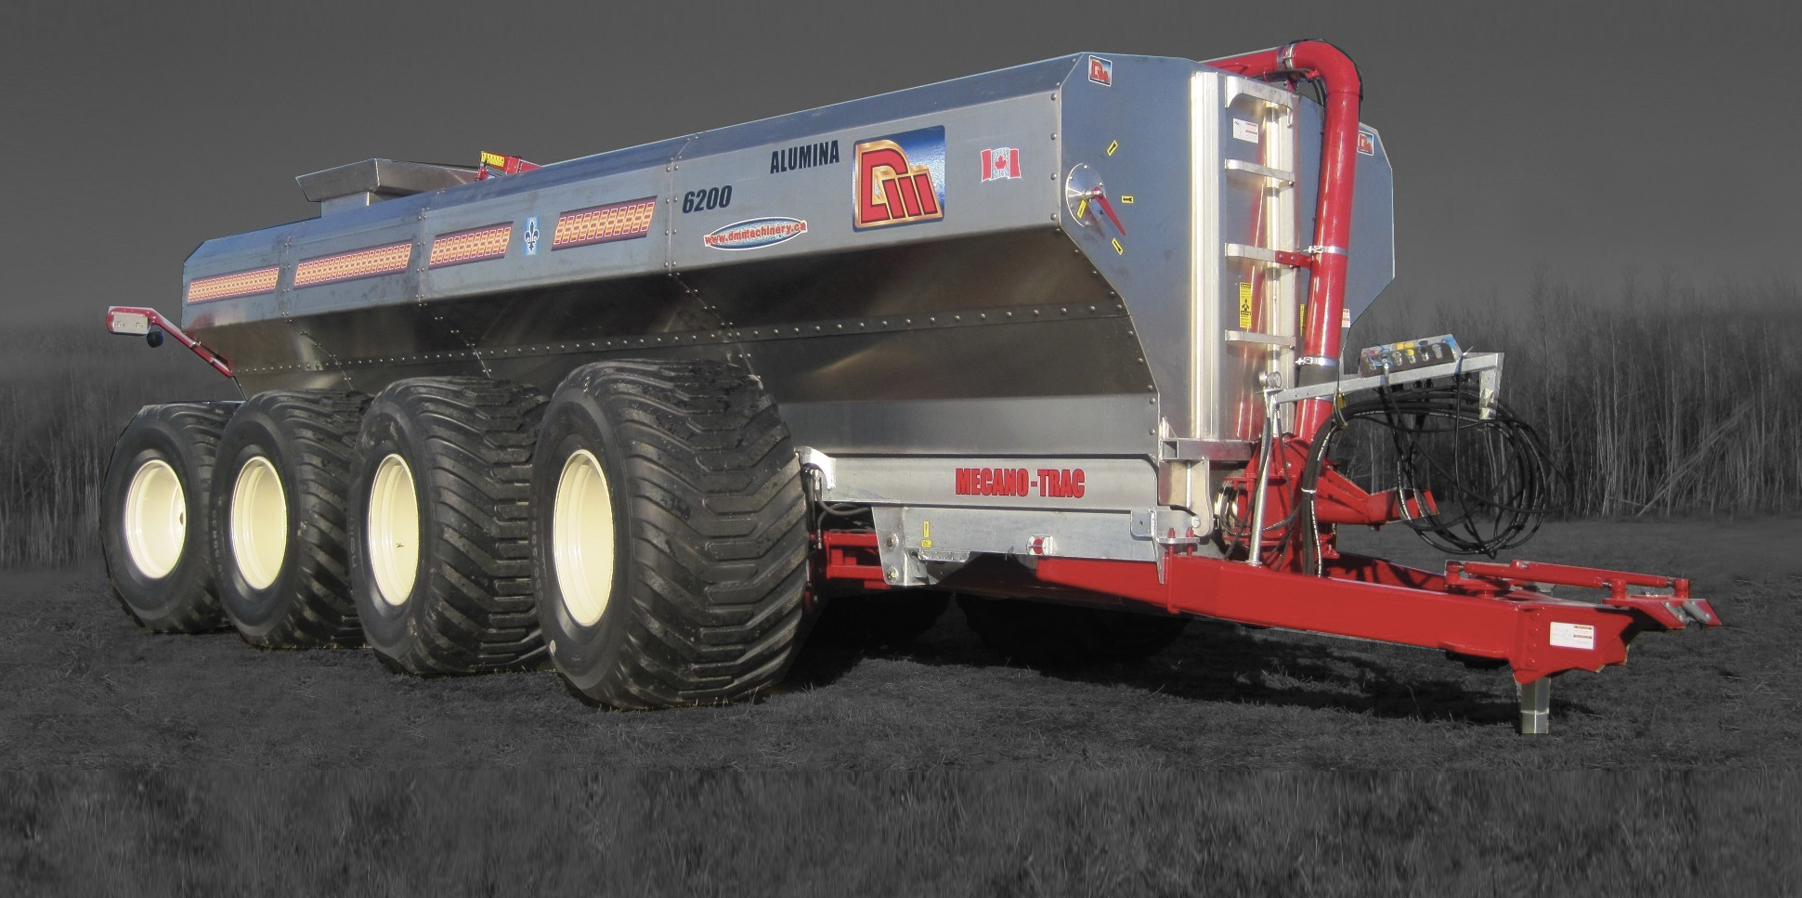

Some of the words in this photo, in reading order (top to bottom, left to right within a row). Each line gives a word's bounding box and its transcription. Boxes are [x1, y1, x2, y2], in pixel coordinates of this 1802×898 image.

[770, 140, 840, 174] ALUMINA
[682, 185, 732, 214] 6200
[705, 221, 807, 245] www.dmmachinery.ca
